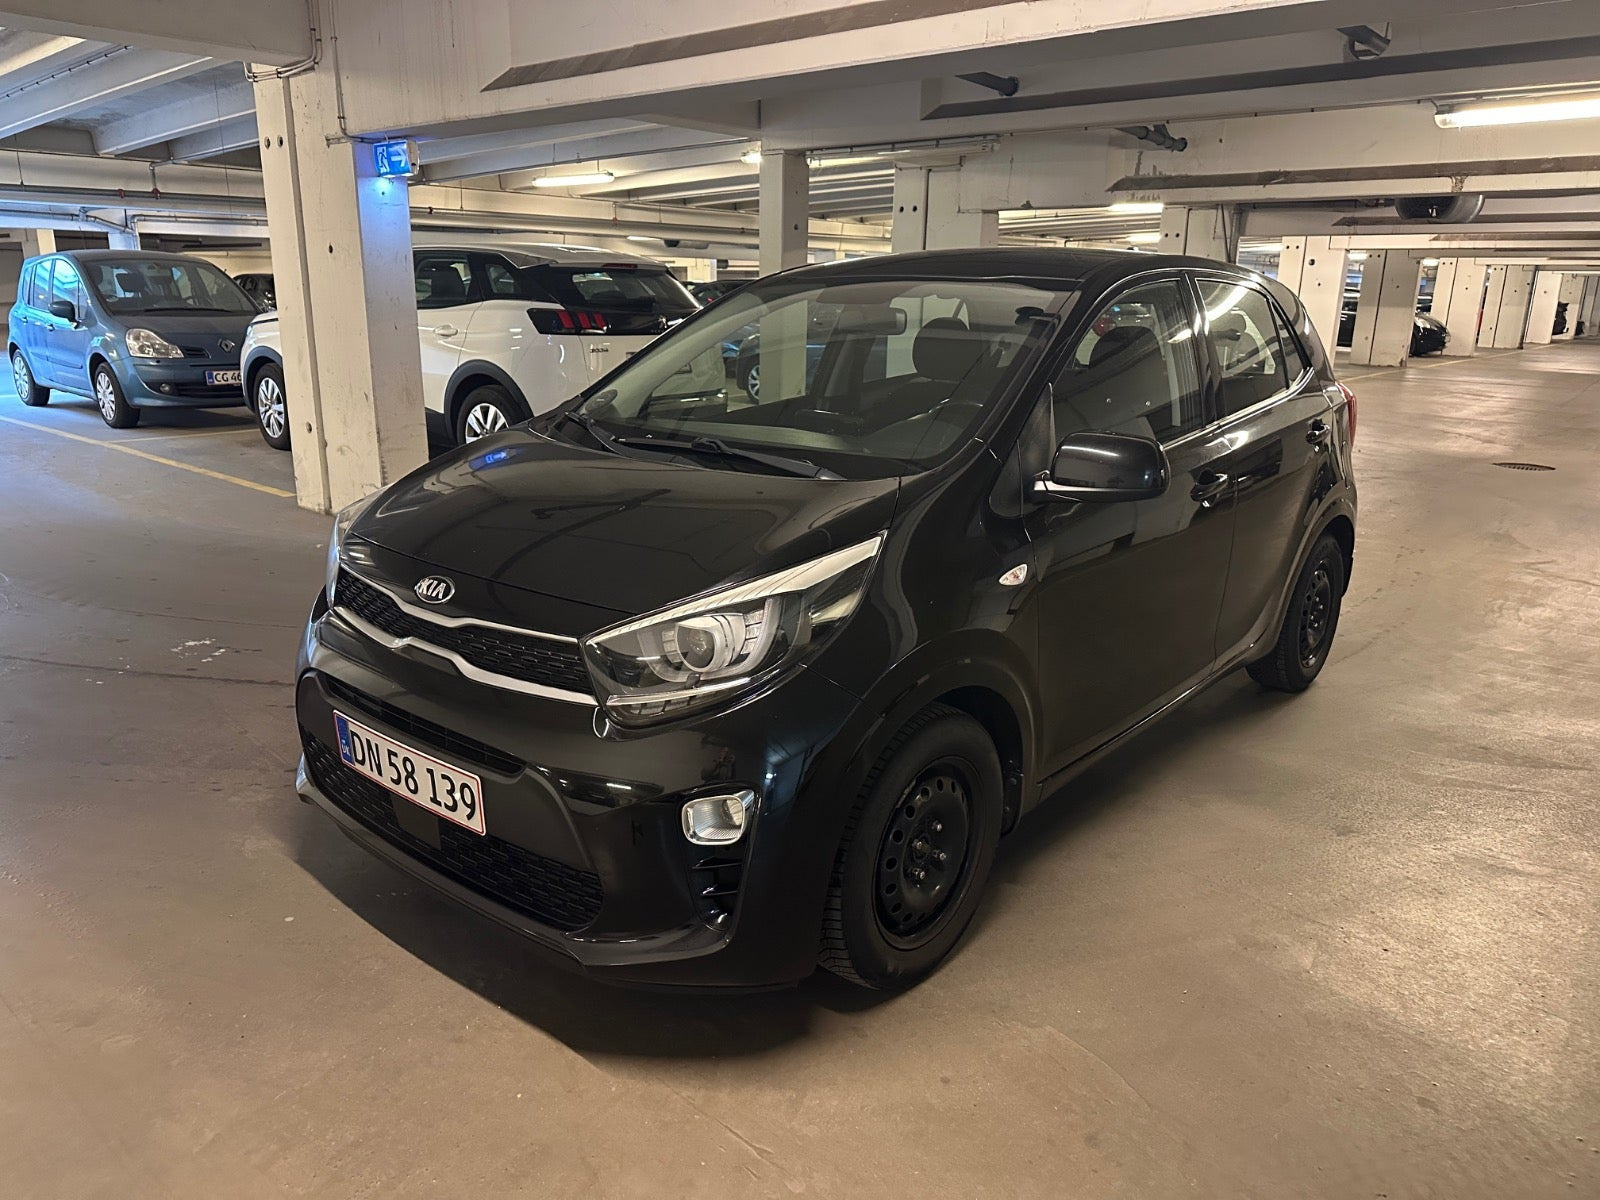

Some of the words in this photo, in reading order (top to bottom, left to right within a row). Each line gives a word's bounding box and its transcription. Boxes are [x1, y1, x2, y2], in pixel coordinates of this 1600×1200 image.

[214, 372, 229, 383] CG
[418, 578, 447, 600] KIA
[351, 730, 383, 777] DN
[387, 748, 419, 795] 58
[426, 767, 476, 821] 139
